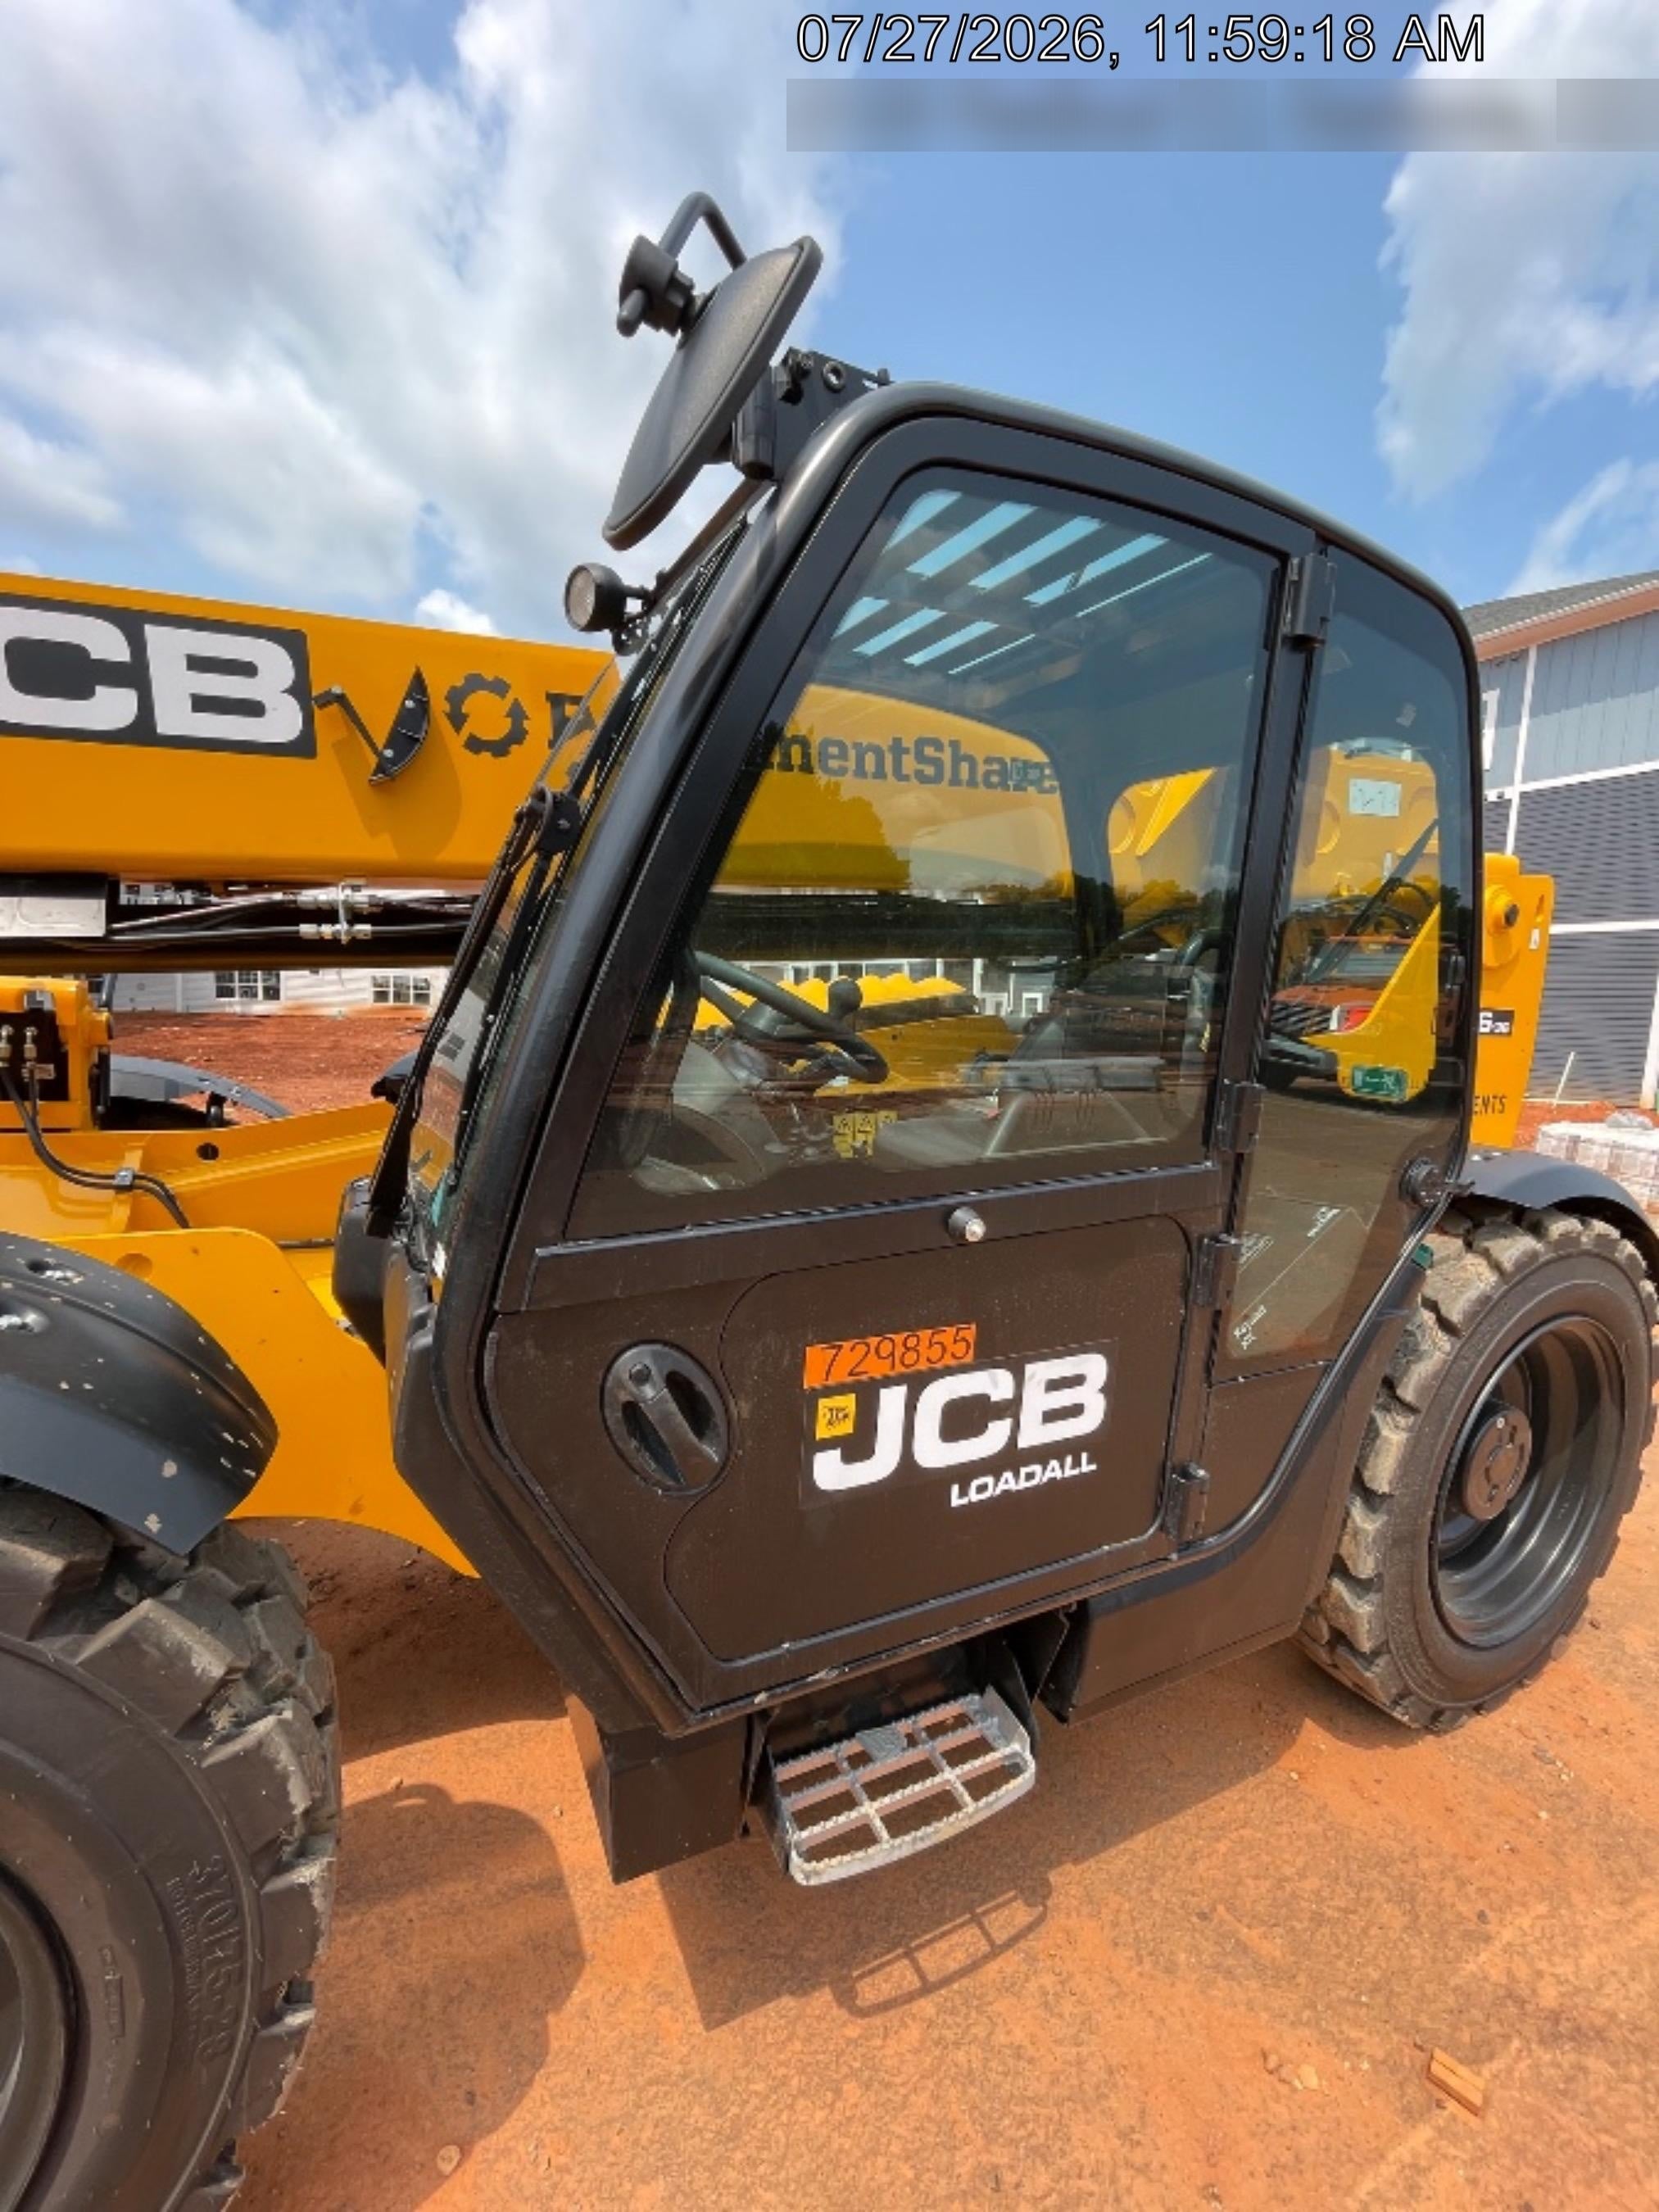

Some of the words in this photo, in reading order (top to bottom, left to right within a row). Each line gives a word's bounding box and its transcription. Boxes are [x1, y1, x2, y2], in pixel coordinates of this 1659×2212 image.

[821, 1325, 974, 1383] 729855
[813, 1352, 1108, 1491] JCB
[949, 1451, 1099, 1508] LOADALL
